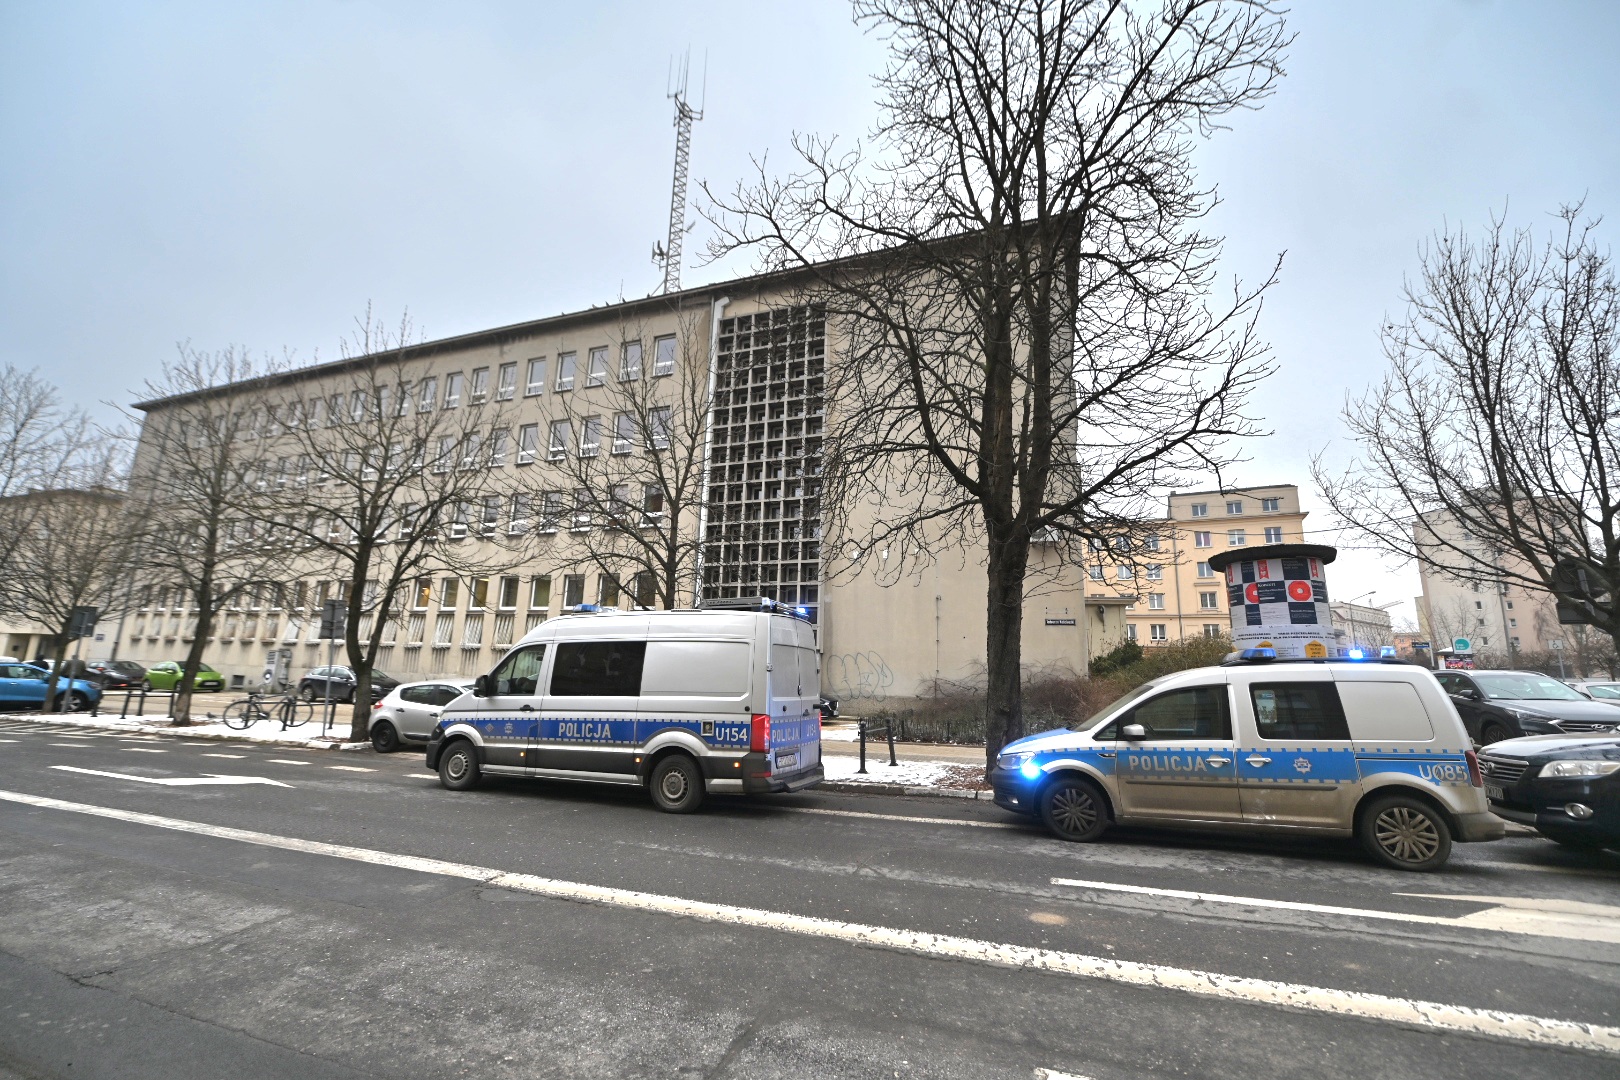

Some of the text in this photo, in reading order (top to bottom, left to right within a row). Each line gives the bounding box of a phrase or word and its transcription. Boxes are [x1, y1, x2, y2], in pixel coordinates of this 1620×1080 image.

[558, 722, 611, 739] POLICJA
[715, 727, 748, 742] U154
[772, 727, 800, 743] POLICJA
[1128, 755, 1208, 772] POLICJA
[1418, 764, 1468, 782] U085
